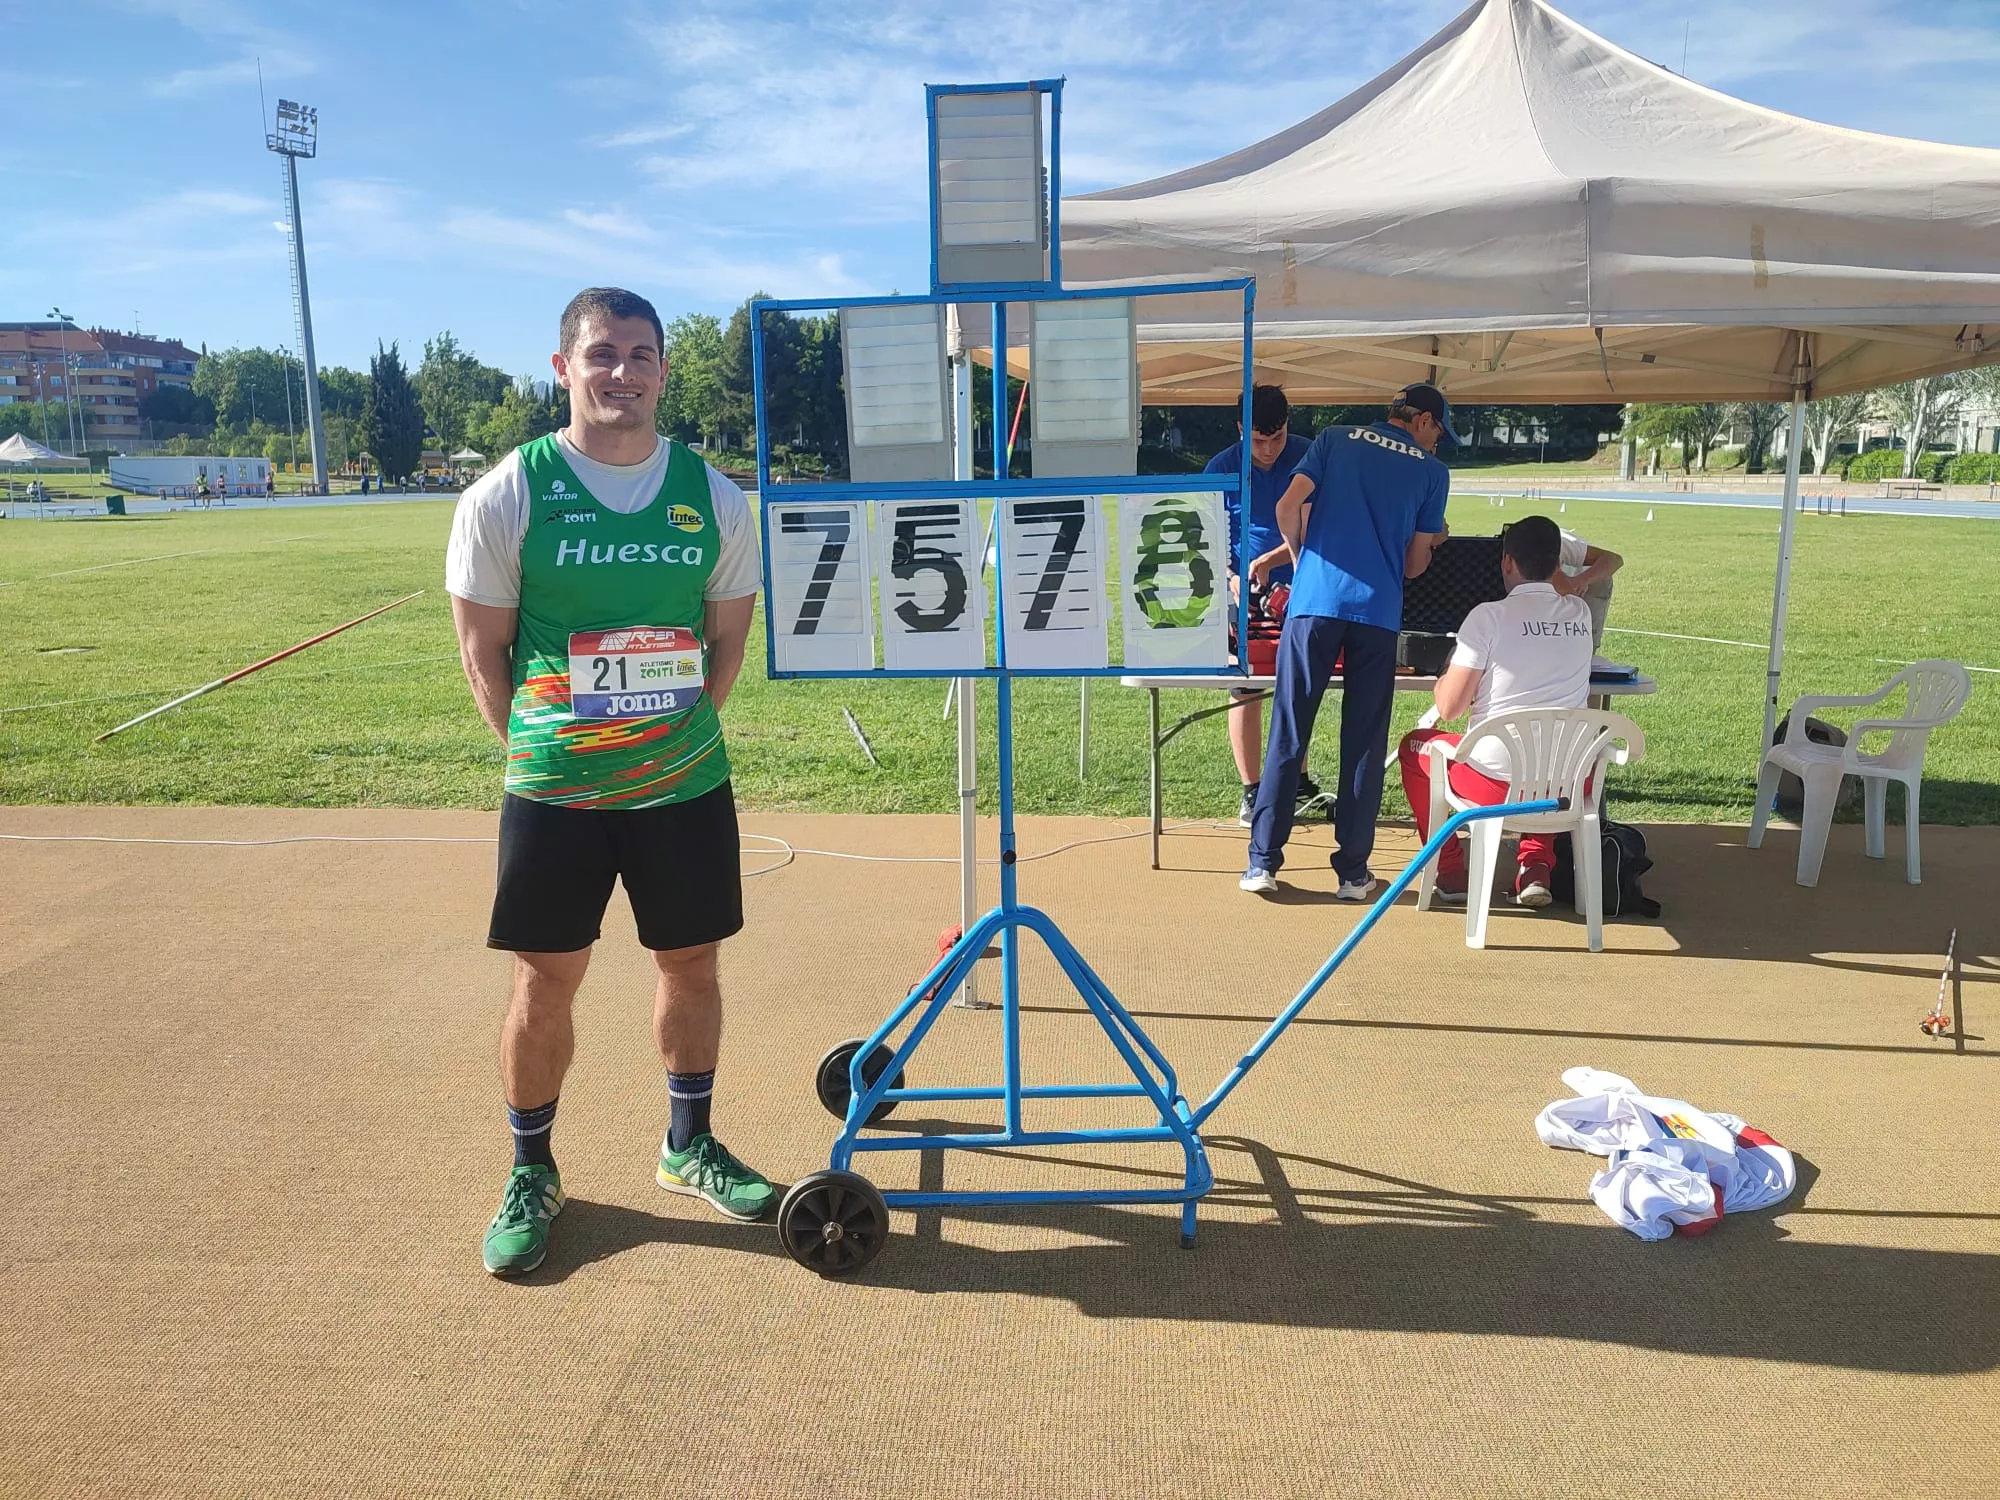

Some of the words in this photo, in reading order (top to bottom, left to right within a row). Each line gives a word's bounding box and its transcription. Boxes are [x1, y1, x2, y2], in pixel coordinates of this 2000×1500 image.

[542, 493, 578, 501] VIATOR
[564, 513, 597, 523] ZOITI
[556, 538, 703, 566] Huesca
[1521, 621, 1562, 637] JUEZ
[1564, 622, 1590, 637] FAA
[626, 642, 675, 650] ATLETISMO
[639, 660, 674, 668] ATLETISMO
[592, 656, 628, 692] 21
[639, 667, 674, 679] ZOITI
